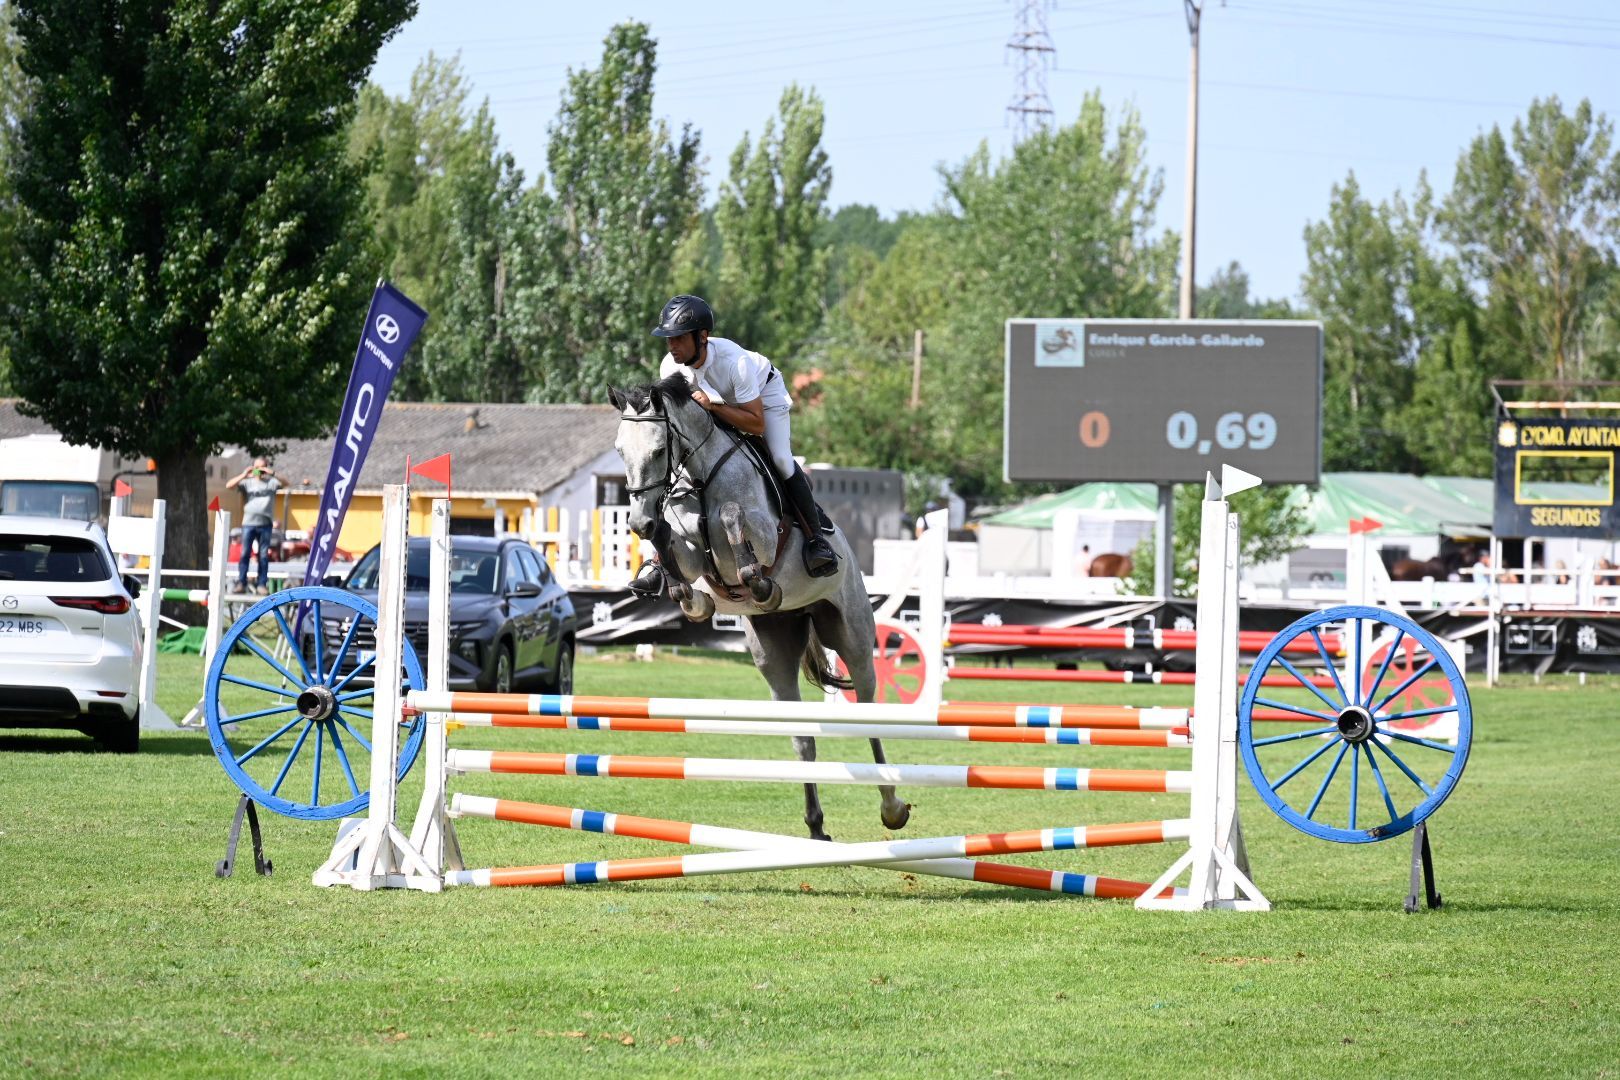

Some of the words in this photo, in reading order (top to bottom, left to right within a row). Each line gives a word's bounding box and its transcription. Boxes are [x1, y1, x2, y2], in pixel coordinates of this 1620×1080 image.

[1089, 333, 1146, 346] Enrique
[364, 338, 394, 370] HYUNDAI
[1079, 411, 1111, 448] 0
[1166, 411, 1278, 454] 0,69
[1567, 426, 1620, 447] AYUNTA
[1530, 507, 1602, 527] SEGUNDOS
[18, 620, 43, 634] MBS
